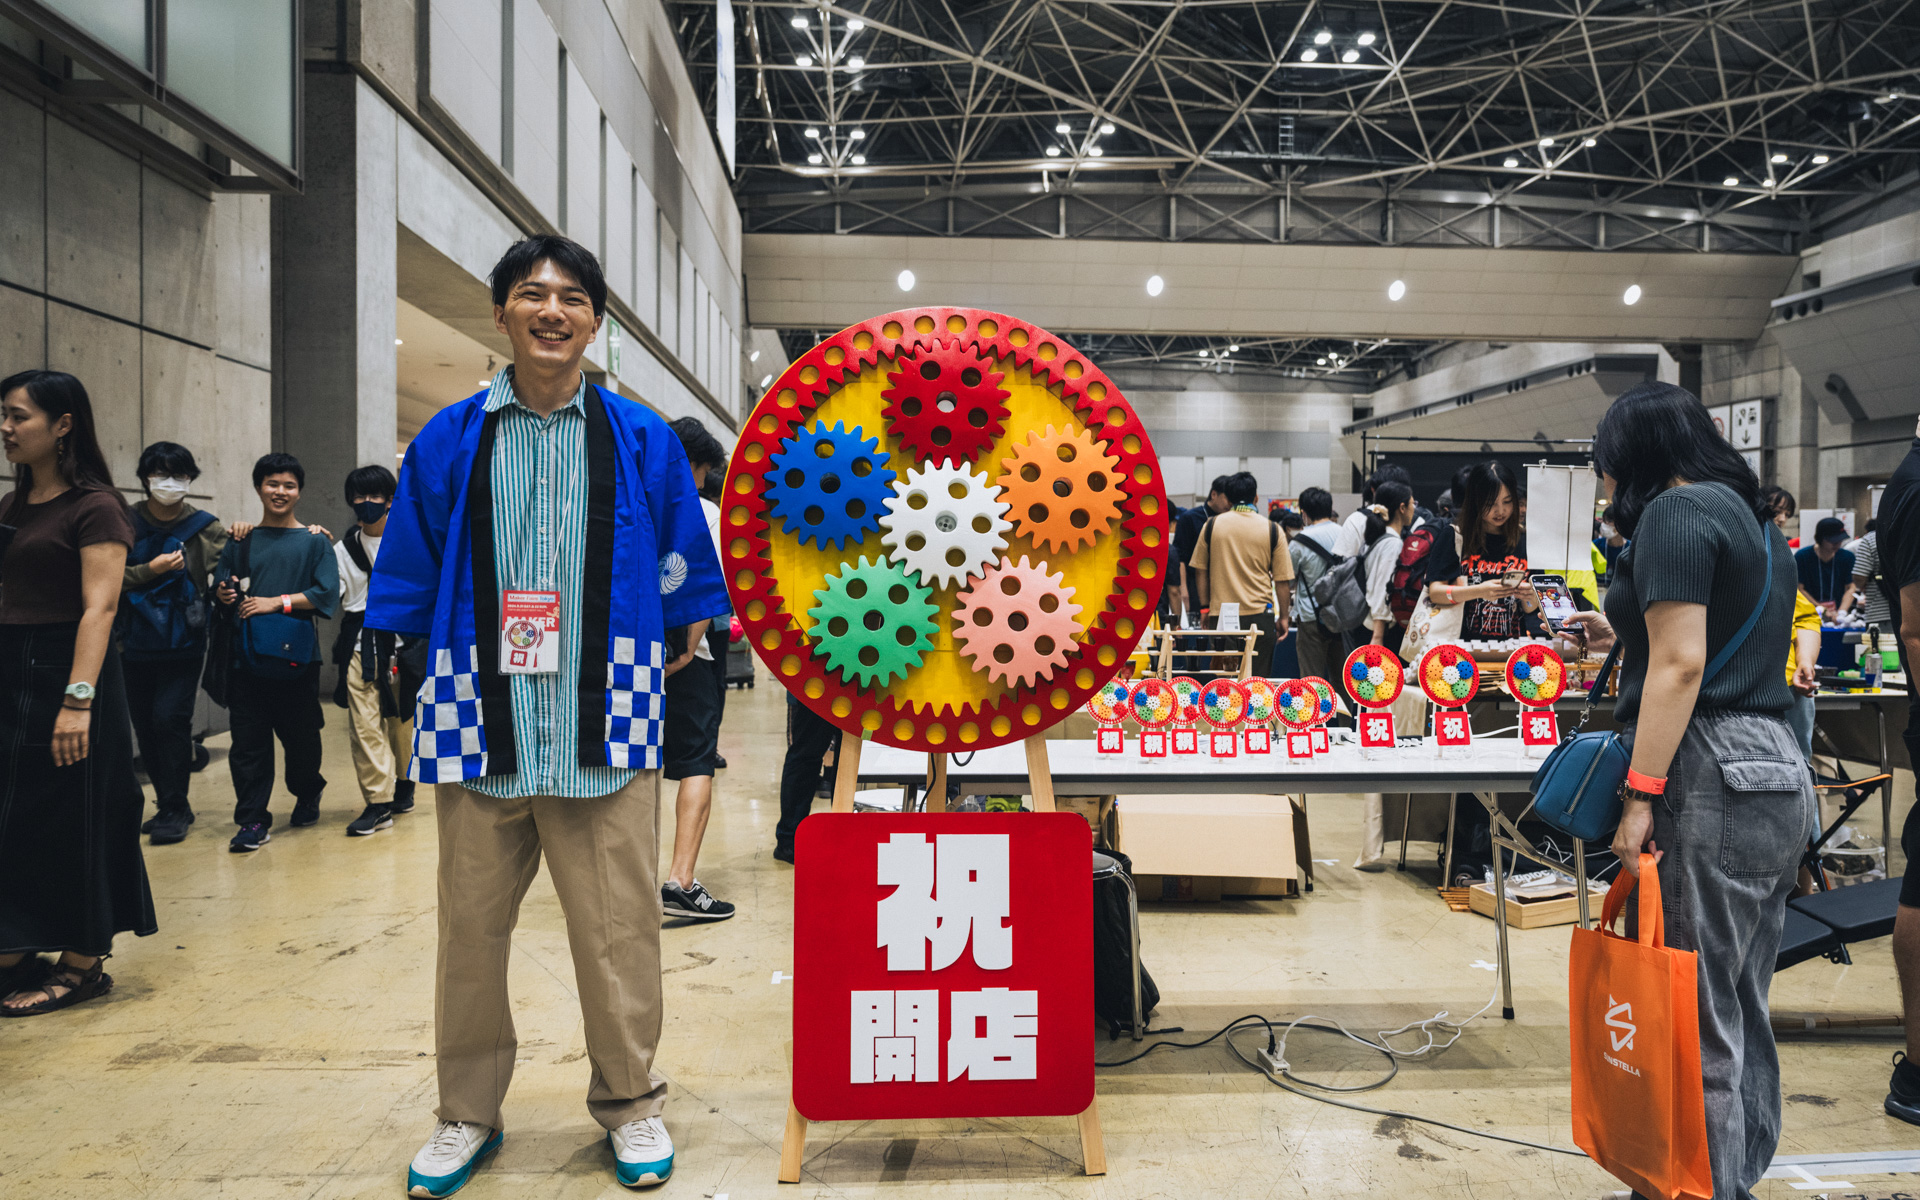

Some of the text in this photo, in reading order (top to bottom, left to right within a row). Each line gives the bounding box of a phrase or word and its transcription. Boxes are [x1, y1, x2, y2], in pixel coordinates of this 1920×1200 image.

[1367, 718, 1390, 741] 祝
[1443, 717, 1464, 739] 祝
[1530, 717, 1552, 739] 祝
[1101, 731, 1120, 750] 祝
[1144, 735, 1163, 754] 祝
[1176, 732, 1195, 751] 祝
[1214, 735, 1234, 754] 祝
[1249, 732, 1268, 751] 祝
[1292, 736, 1310, 755] 祝
[877, 833, 1013, 972] 祝
[850, 987, 1039, 1084] 開店
